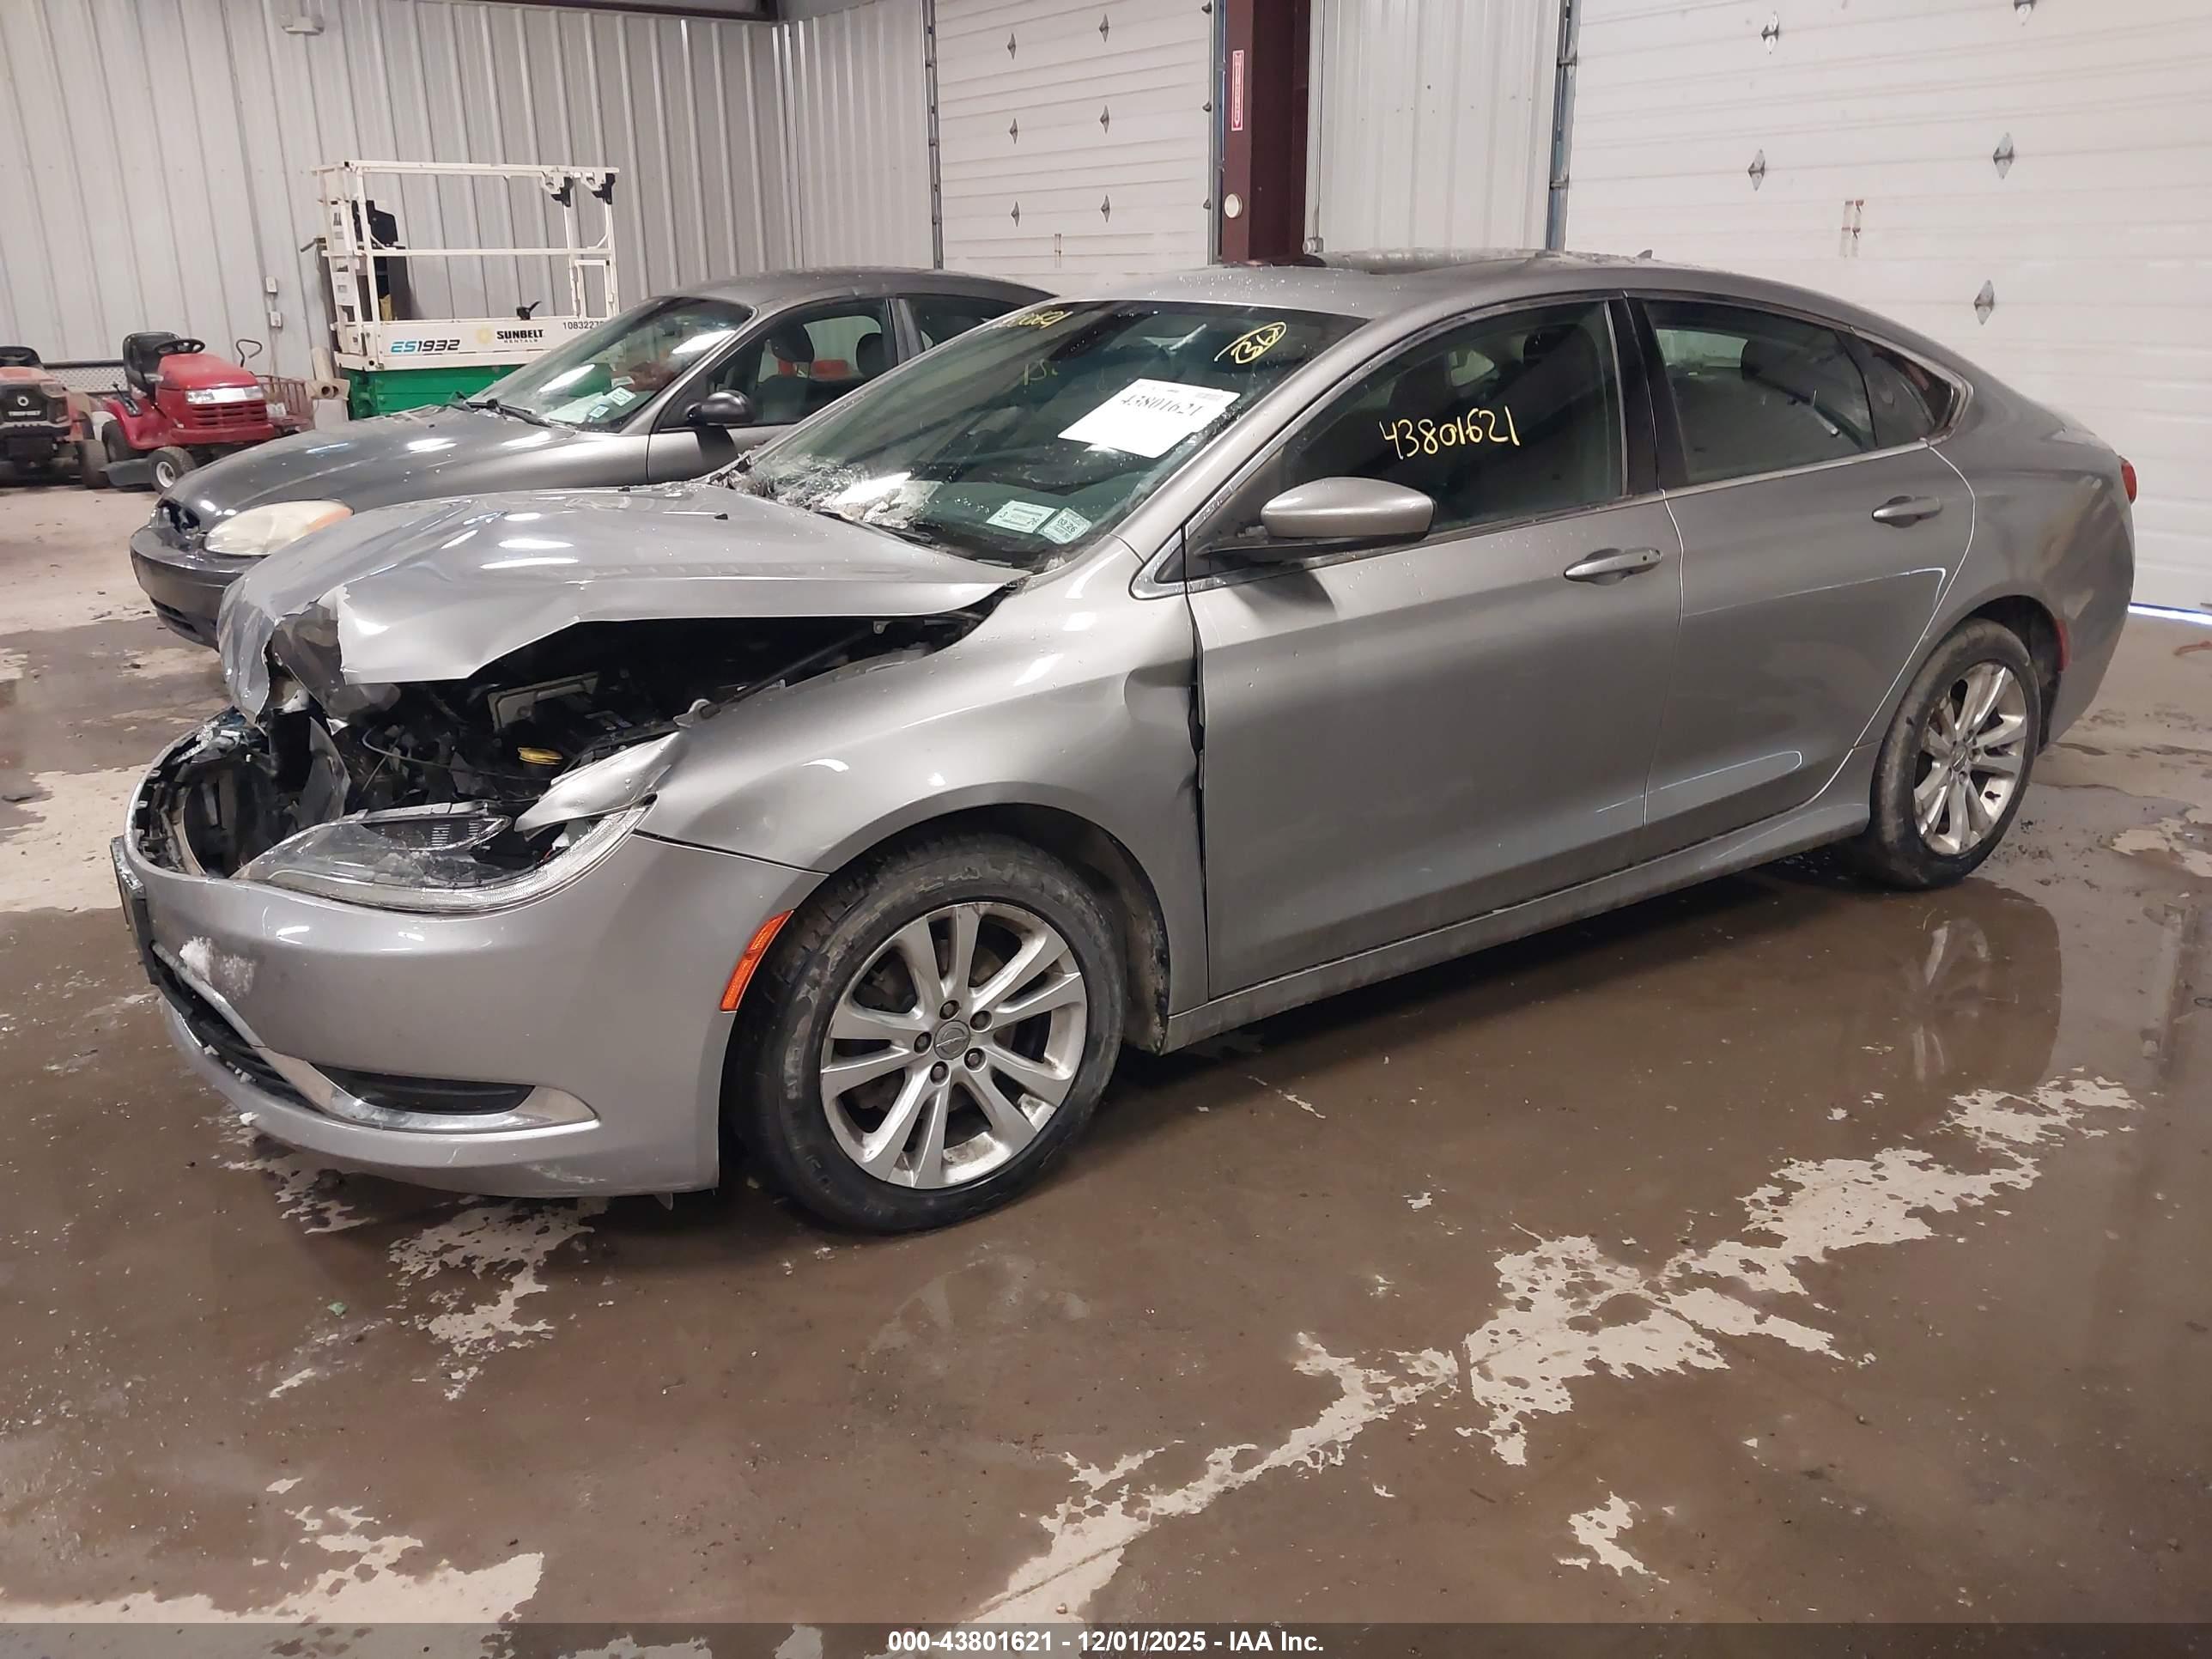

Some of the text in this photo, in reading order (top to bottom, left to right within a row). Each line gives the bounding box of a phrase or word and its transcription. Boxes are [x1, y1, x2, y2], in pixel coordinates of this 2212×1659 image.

[562, 320, 605, 330] 1083227
[496, 329, 544, 339] SUNBELT
[391, 339, 461, 353] ES1932
[1379, 405, 1521, 460] 43801621
